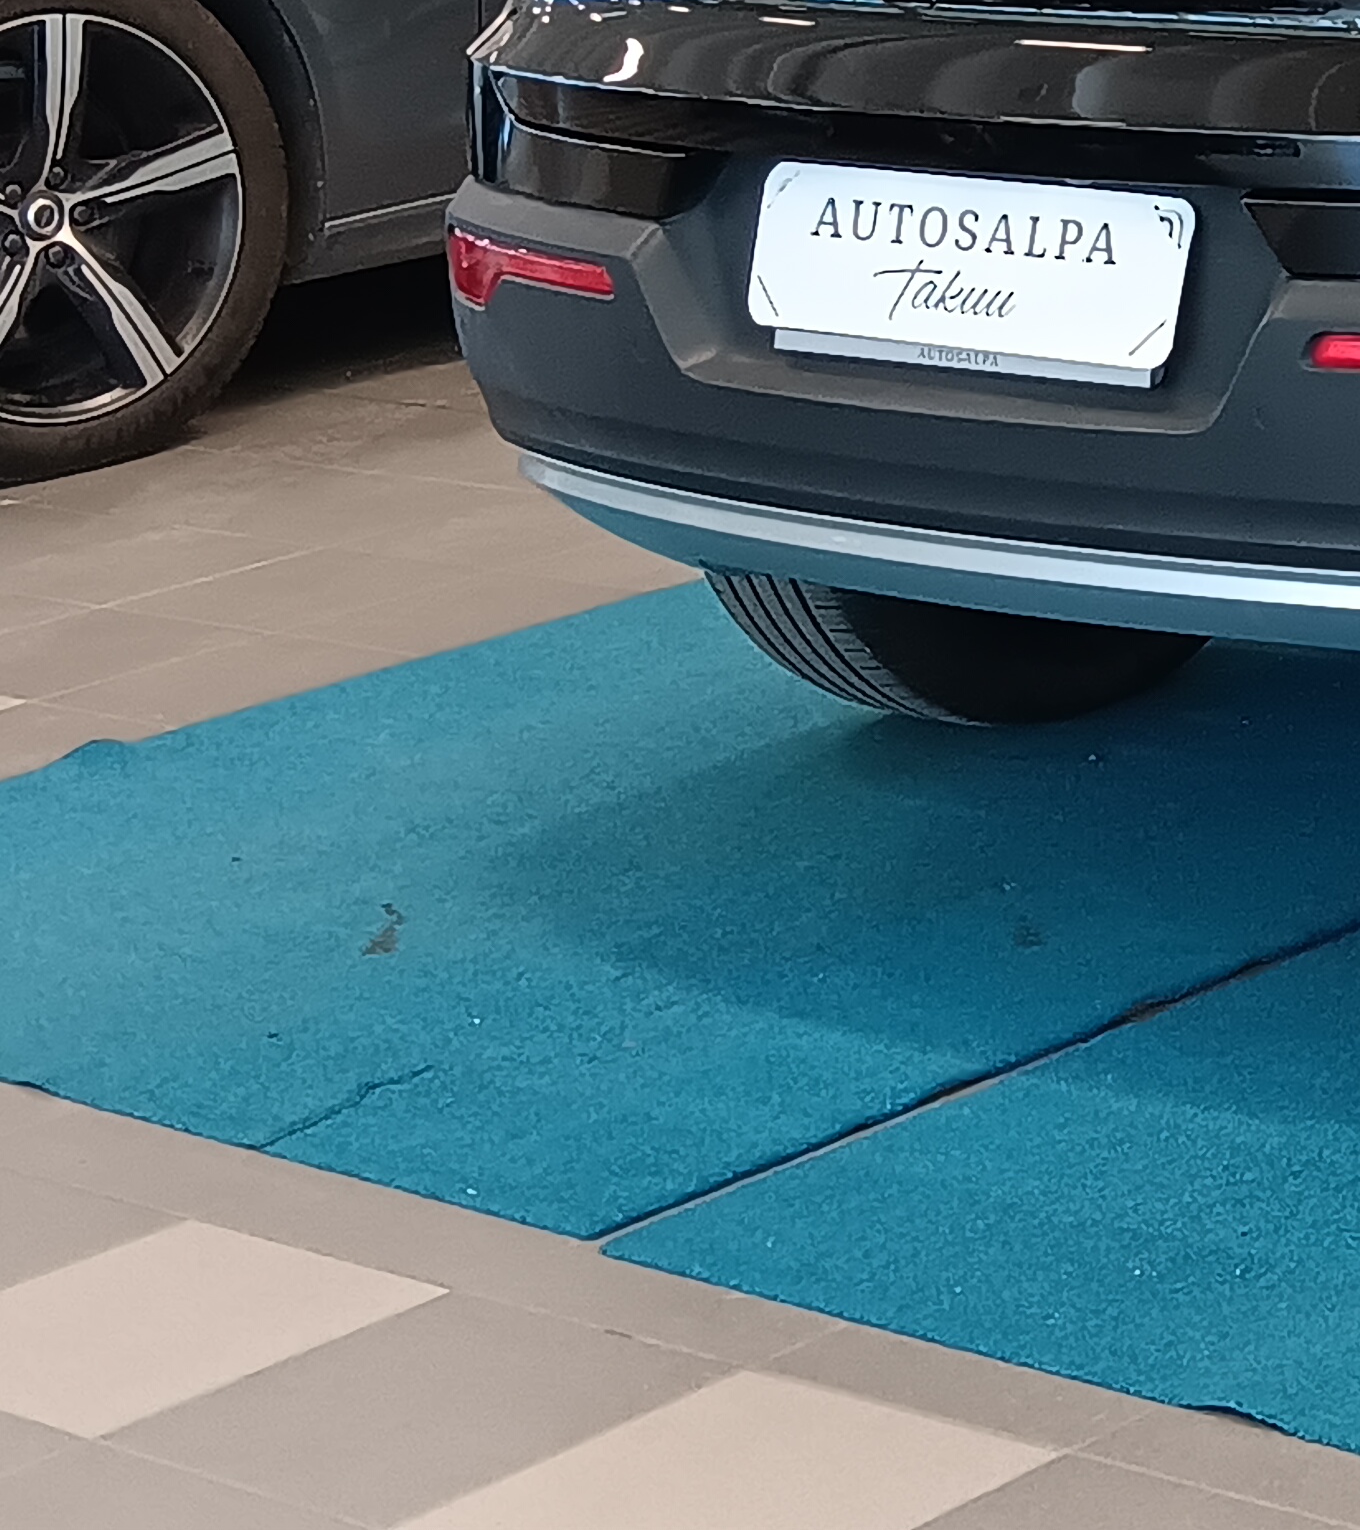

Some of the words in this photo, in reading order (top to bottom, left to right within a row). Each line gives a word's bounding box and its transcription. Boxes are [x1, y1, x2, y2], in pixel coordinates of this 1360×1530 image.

[809, 196, 1118, 266] AUTOSALPA
[873, 259, 1018, 321] Takuu
[916, 346, 1000, 368] AUTOSALPA
